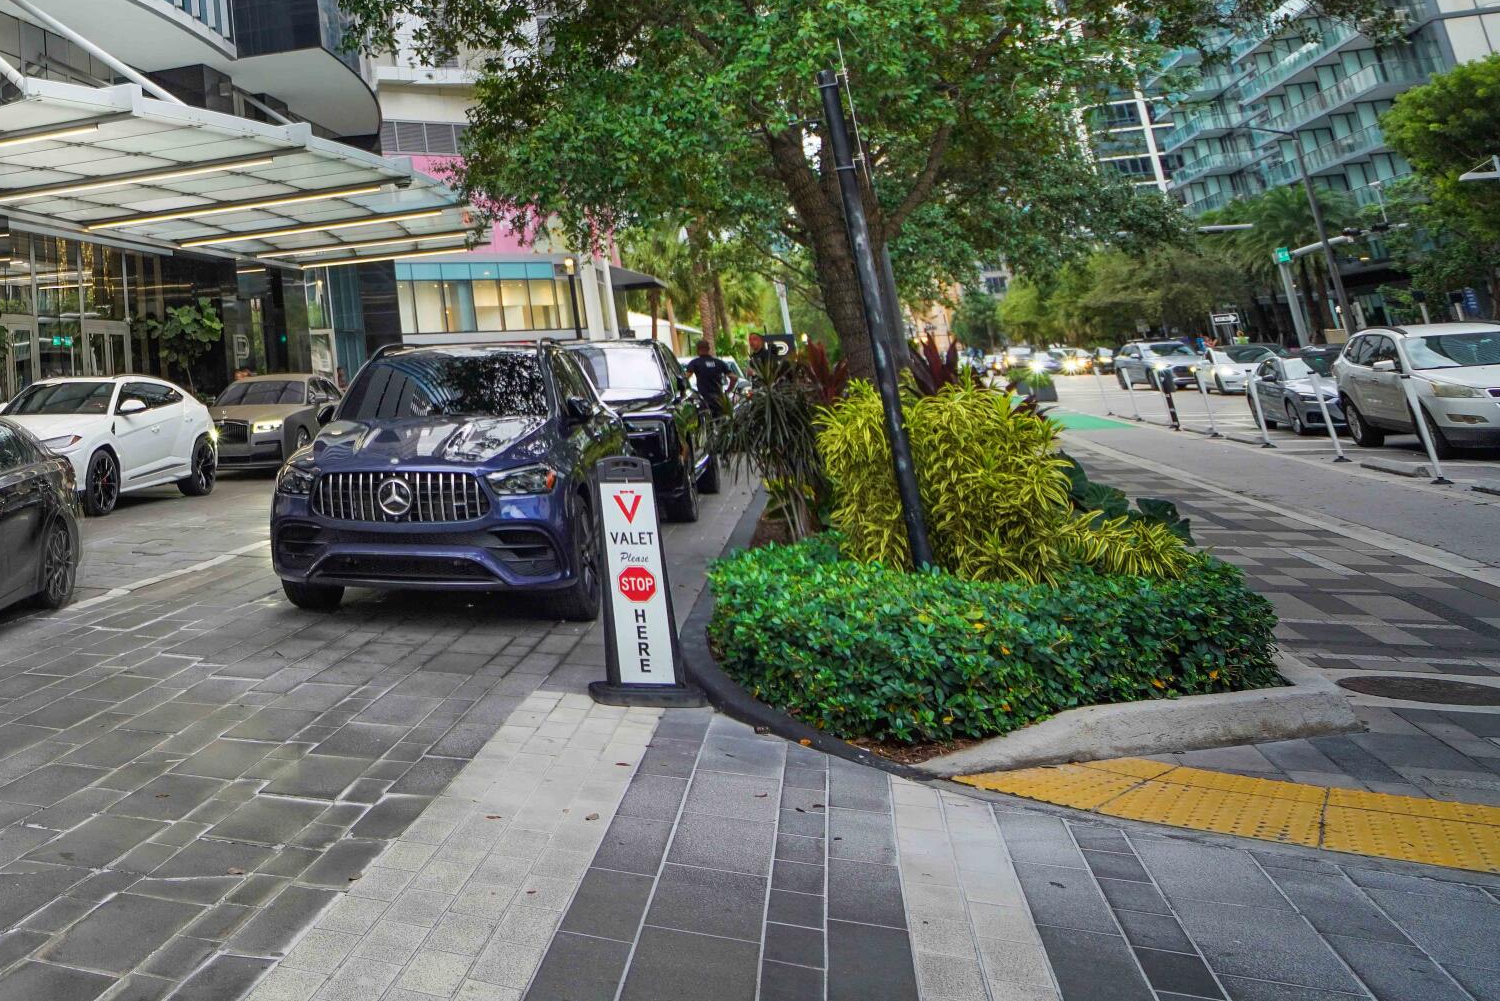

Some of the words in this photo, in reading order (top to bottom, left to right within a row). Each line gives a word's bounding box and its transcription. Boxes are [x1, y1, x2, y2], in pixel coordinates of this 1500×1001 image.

[610, 531, 654, 546] VALET
[620, 551, 650, 564] Please
[621, 577, 654, 592] STOP
[634, 609, 652, 673] HERE
